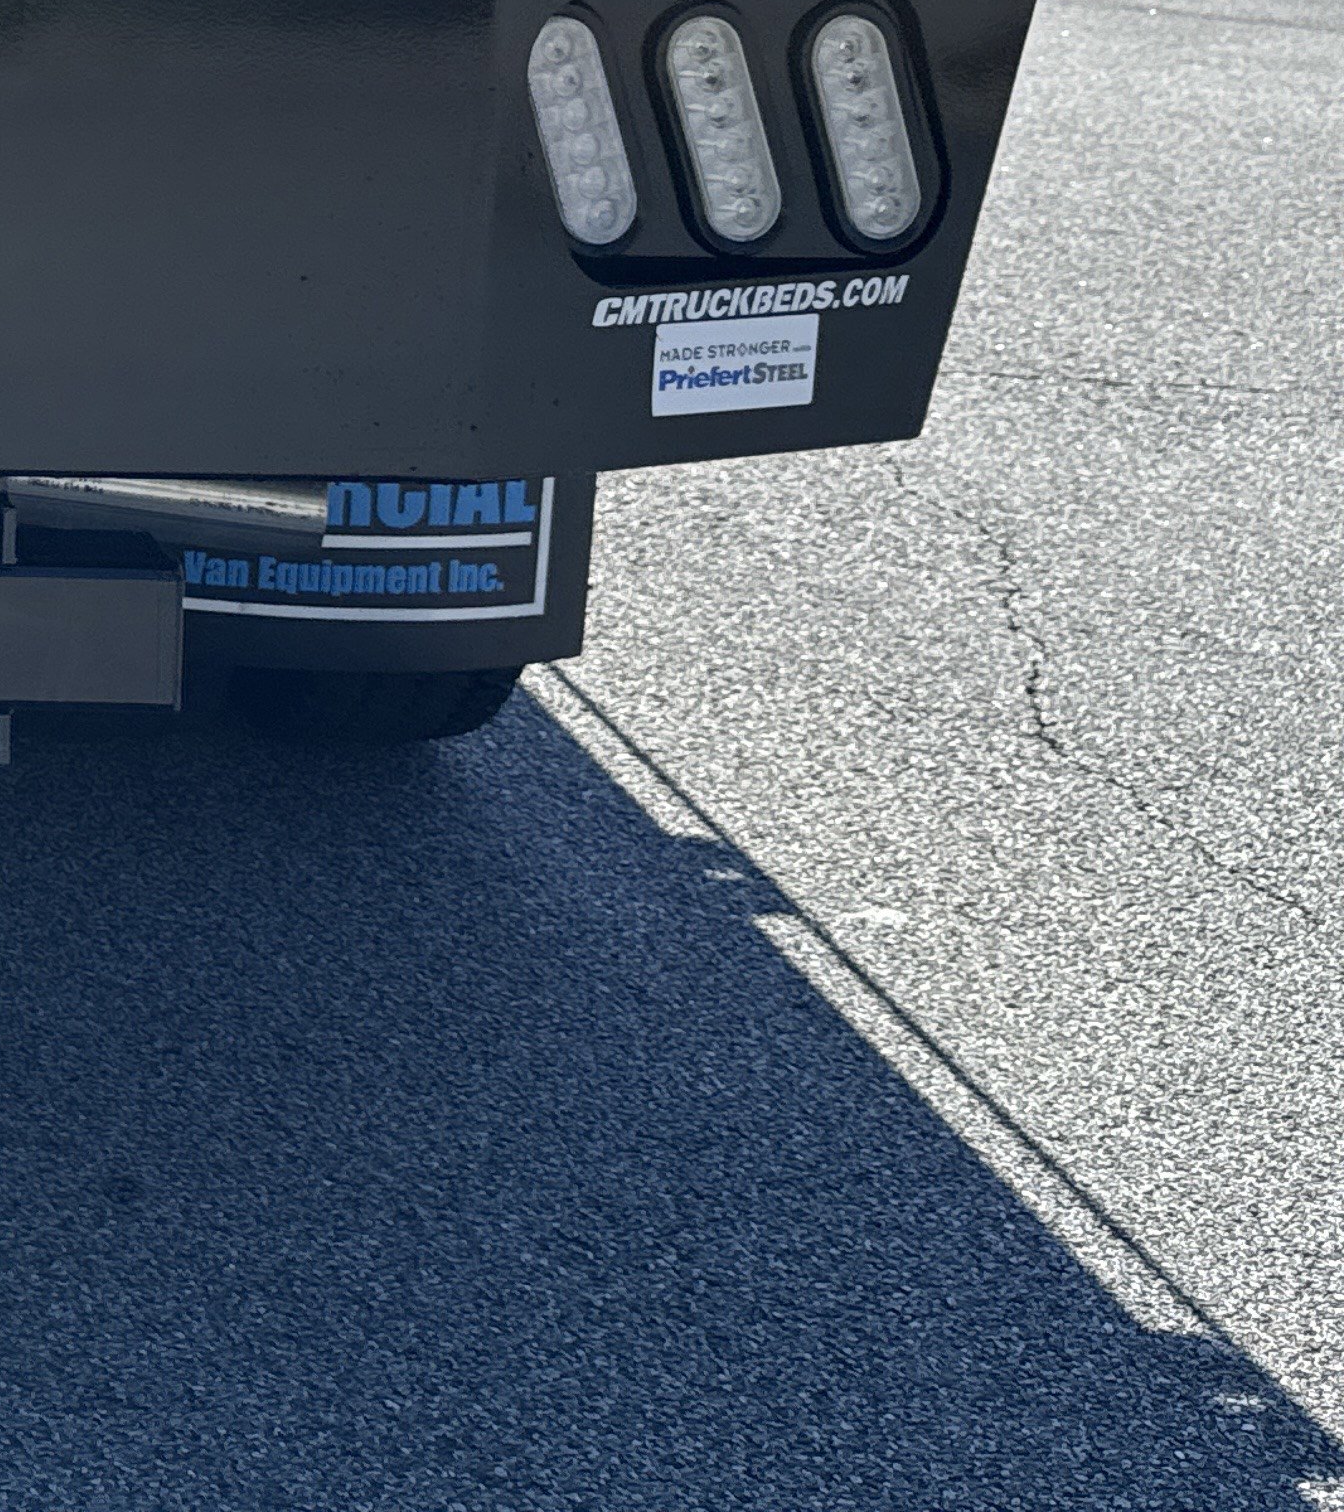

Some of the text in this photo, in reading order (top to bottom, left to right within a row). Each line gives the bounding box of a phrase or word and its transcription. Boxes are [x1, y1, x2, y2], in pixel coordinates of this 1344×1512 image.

[591, 274, 910, 328] CMTRUCKBEDS.COM
[659, 345, 704, 363] MADE
[706, 339, 792, 359] STRONGER
[183, 549, 505, 598] Van Equipment Inc.
